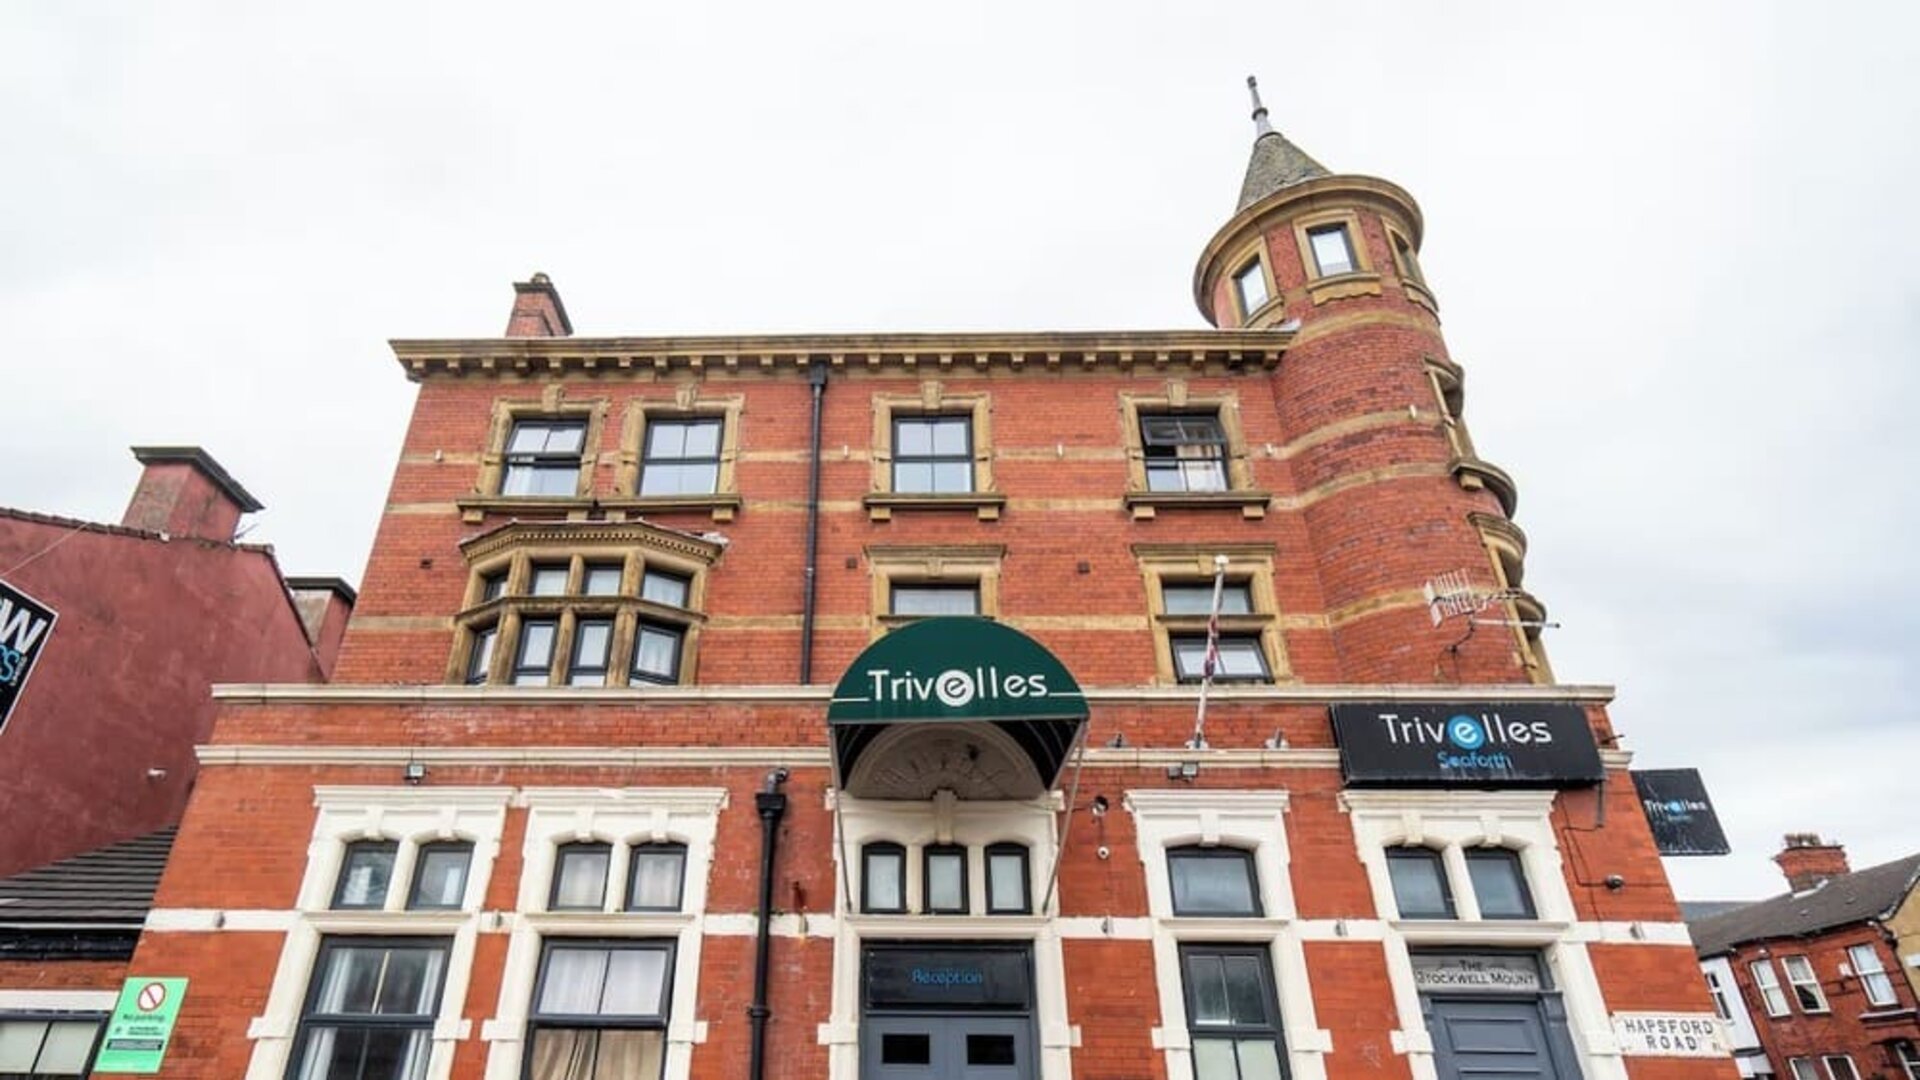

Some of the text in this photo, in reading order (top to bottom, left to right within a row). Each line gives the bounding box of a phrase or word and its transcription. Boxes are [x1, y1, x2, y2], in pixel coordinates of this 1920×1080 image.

[0, 597, 48, 655] W
[867, 667, 1048, 706] Trivelles
[1378, 713, 1553, 750] Trivelles
[1437, 751, 1513, 769] Seaforth
[1459, 959, 1483, 972] THE
[911, 967, 984, 989] Reception
[1489, 971, 1537, 985] MOUNT
[1624, 1018, 1714, 1035] HAPSFORD
[1645, 1035, 1697, 1050] ROAD
